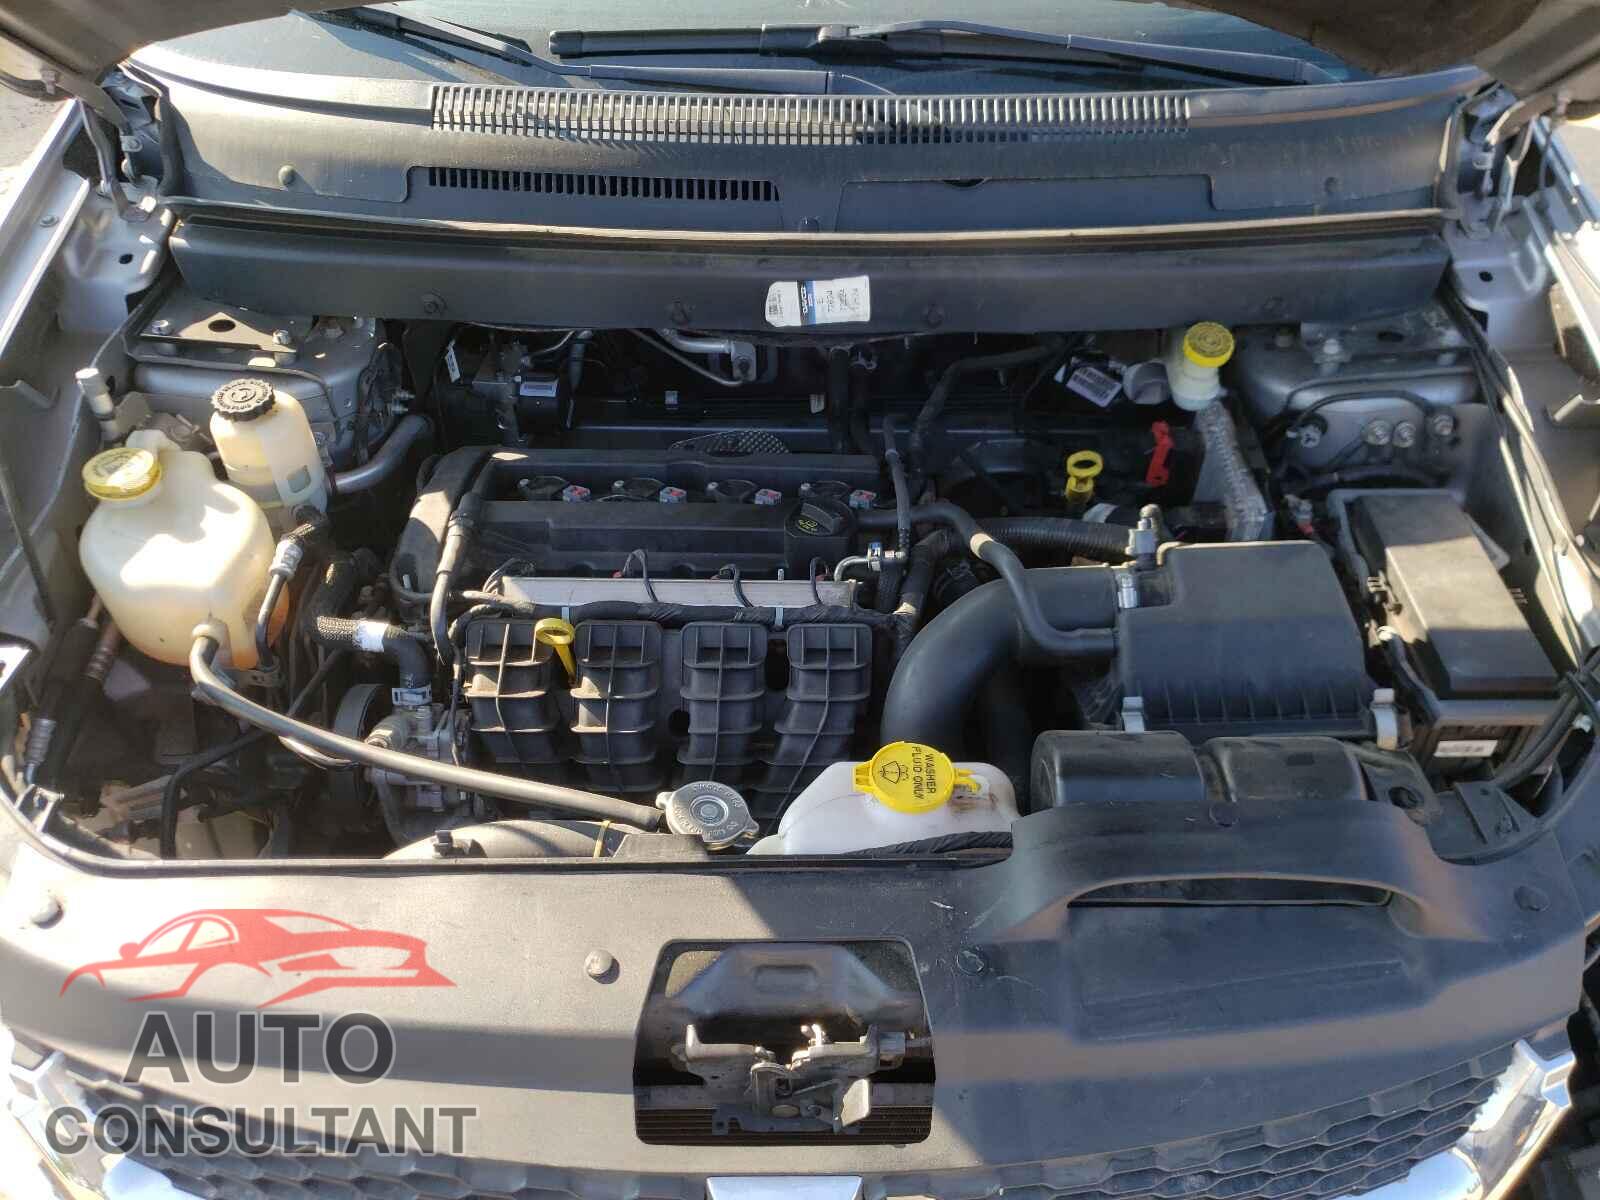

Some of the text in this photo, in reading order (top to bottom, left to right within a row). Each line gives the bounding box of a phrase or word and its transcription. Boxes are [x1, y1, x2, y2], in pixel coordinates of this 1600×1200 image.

[912, 746, 924, 799] FLUID ONLY
[925, 753, 936, 794] WASHER
